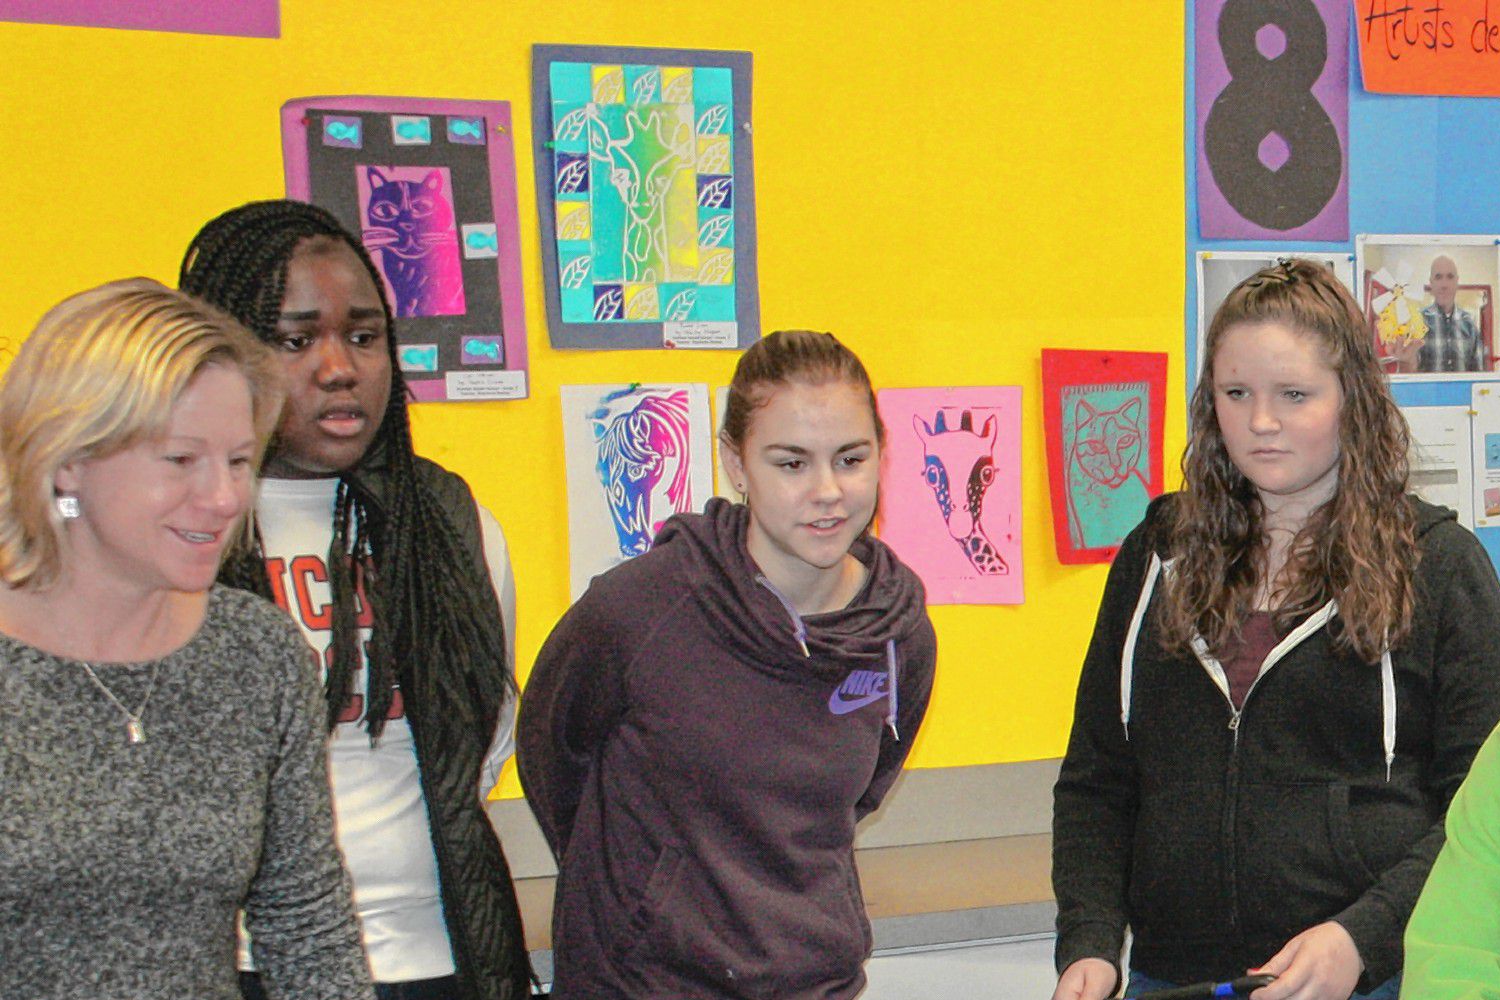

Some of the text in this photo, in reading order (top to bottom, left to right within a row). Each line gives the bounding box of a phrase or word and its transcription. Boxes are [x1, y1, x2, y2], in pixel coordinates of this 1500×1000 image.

[1364, 0, 1454, 60] Artists
[1204, 0, 1342, 231] 8
[840, 670, 888, 695] NIKE
